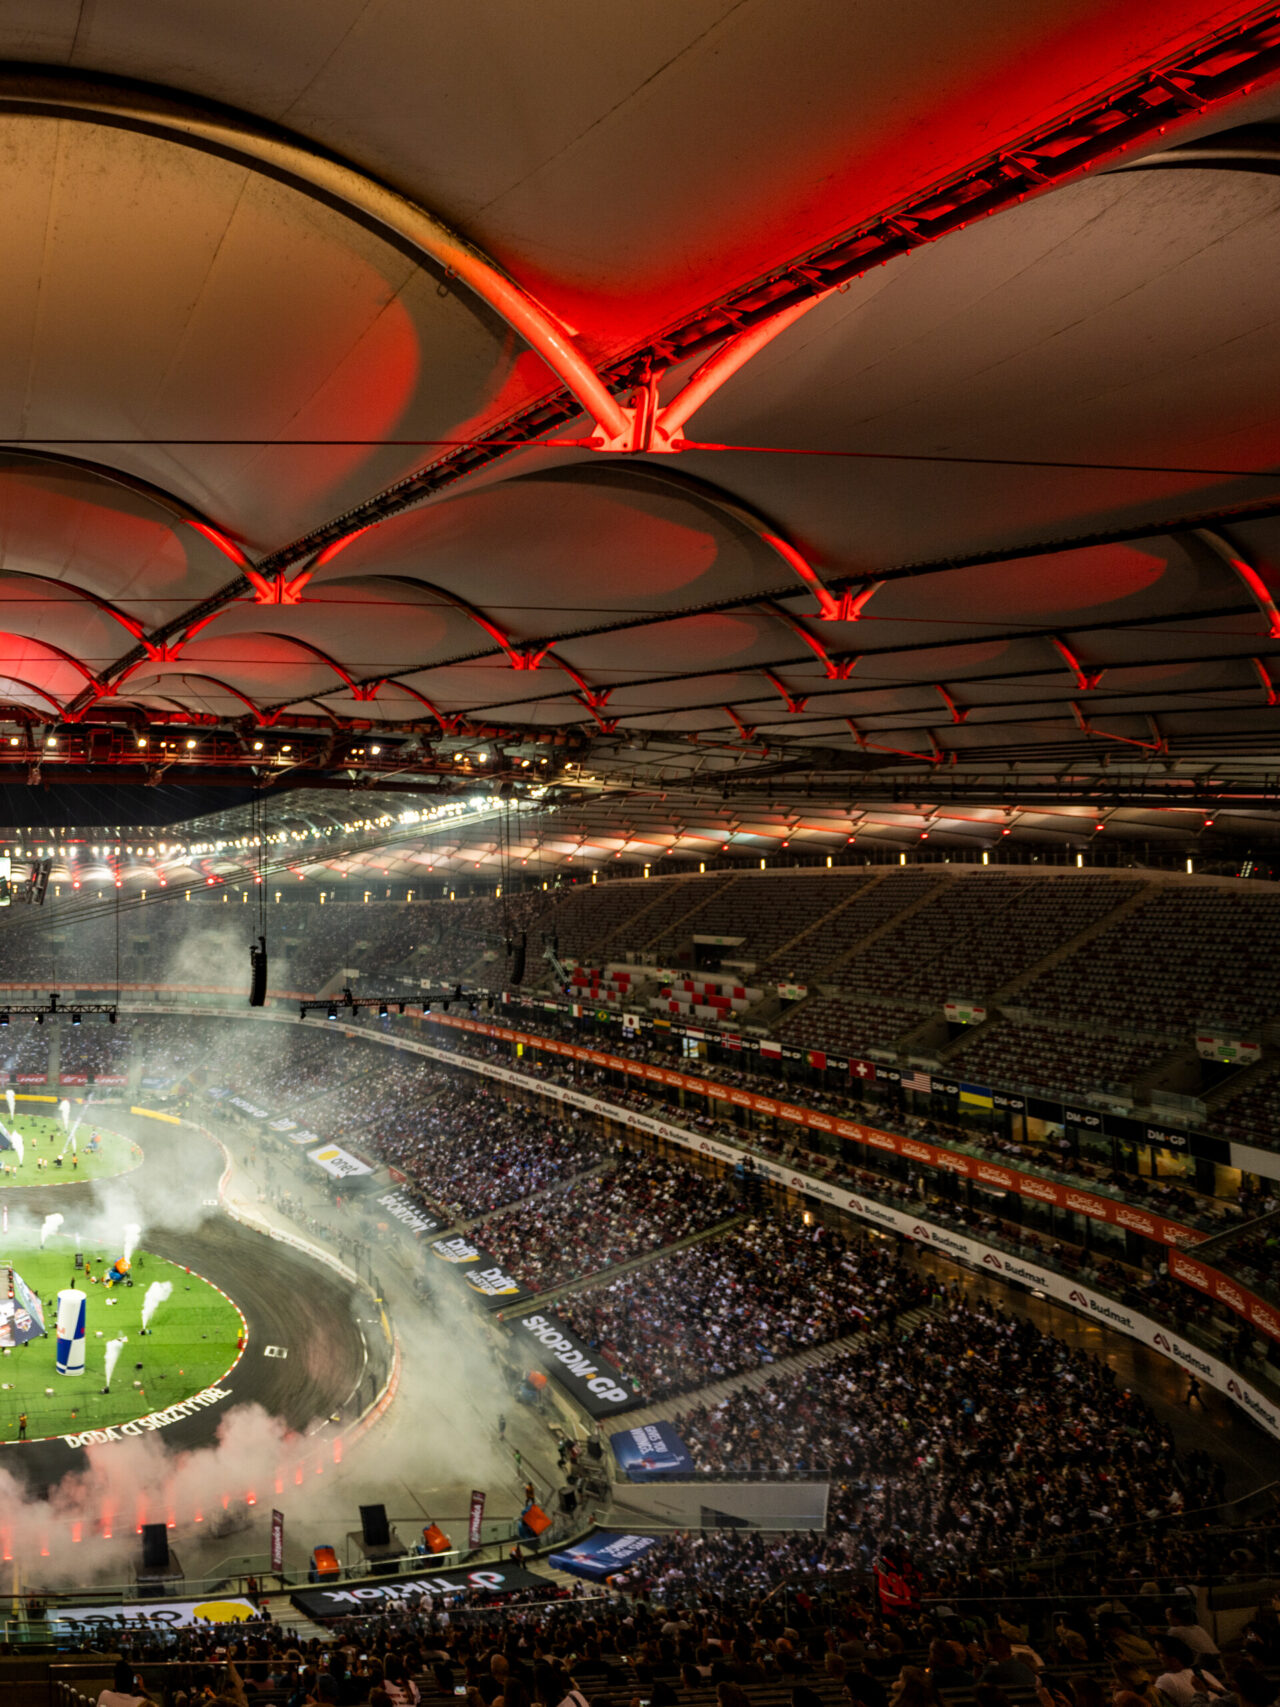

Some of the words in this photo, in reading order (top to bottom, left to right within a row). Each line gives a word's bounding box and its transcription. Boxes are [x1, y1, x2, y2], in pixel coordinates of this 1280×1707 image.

[331, 1157, 359, 1176] onet
[932, 1232, 970, 1254] Budmat.
[480, 1267, 517, 1291] Drift
[1005, 1262, 1048, 1287] Budmat.
[1090, 1300, 1135, 1329] Budmat.
[322, 1578, 466, 1604] TikTok
